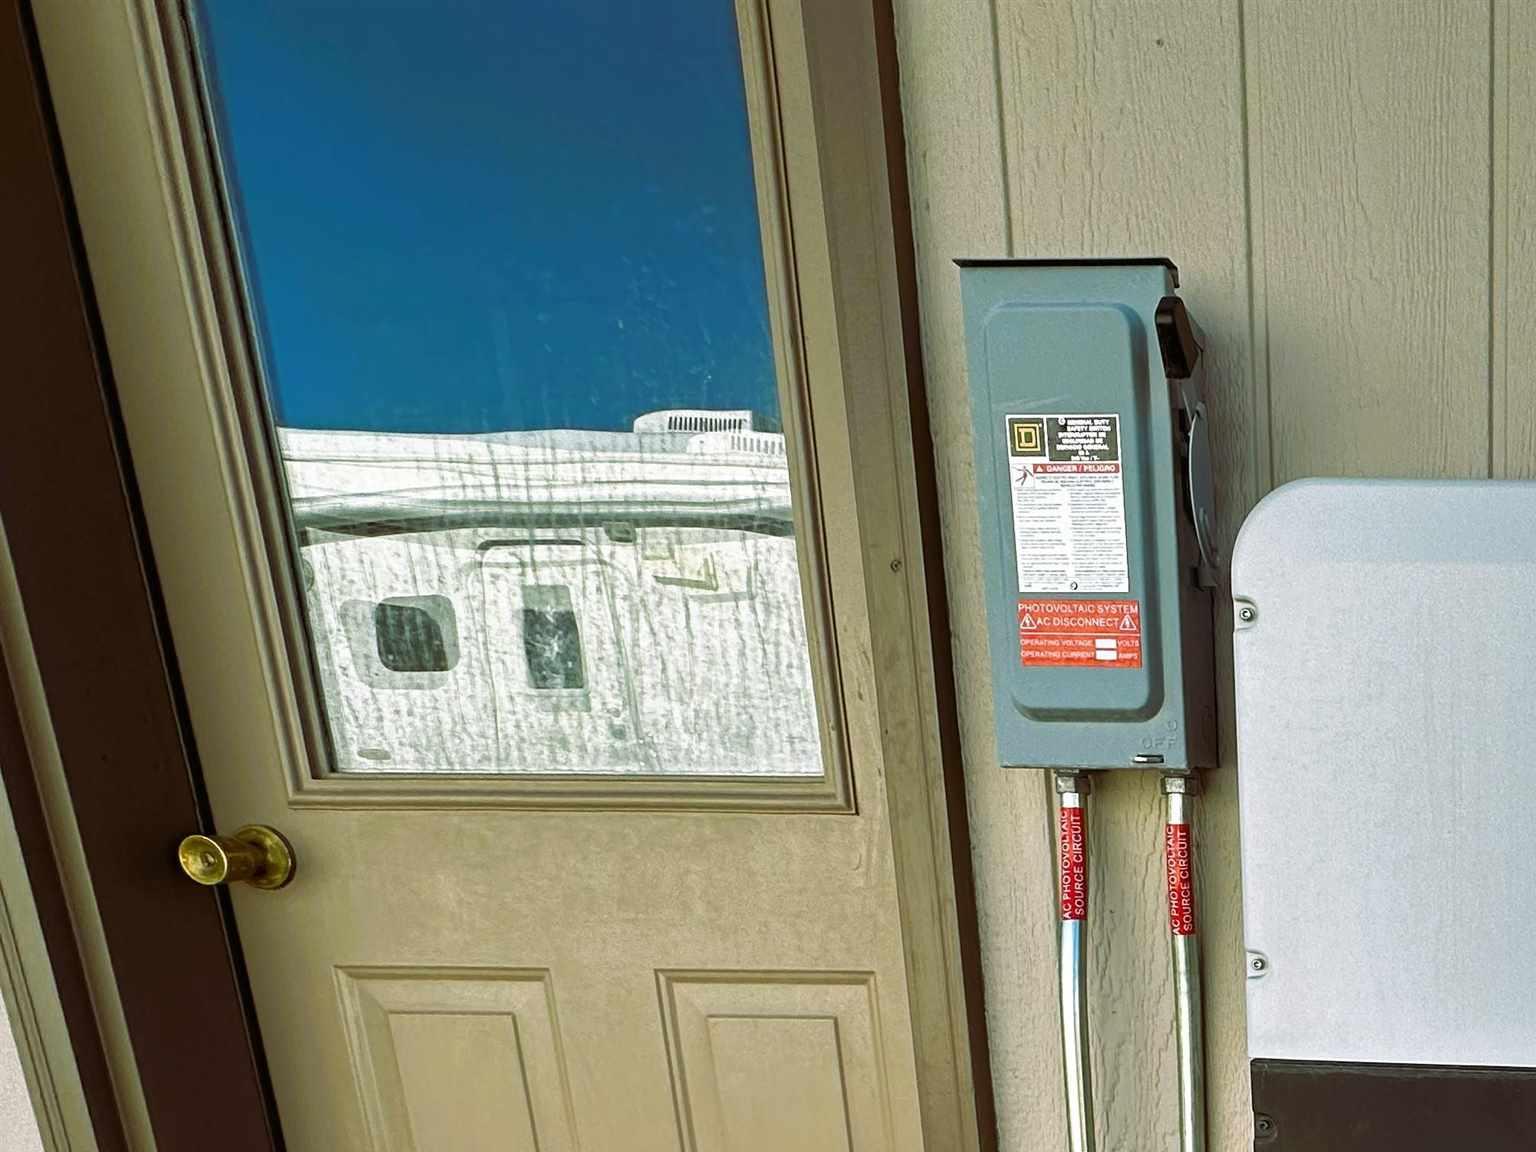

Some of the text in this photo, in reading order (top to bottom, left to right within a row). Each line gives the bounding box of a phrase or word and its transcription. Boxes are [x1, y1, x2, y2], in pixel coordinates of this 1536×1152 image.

[1046, 464, 1077, 472] DANGER
[1083, 464, 1116, 472] PELIGRO
[1018, 603, 1138, 614] PHOTOVOLTAIC SYSTEM
[1036, 616, 1119, 627] AC DISCONNECT
[1061, 810, 1072, 920] AC PHOTOVOLTAIC
[1070, 814, 1085, 916] SOURCE CIRCUIT
[1166, 826, 1181, 935] AC PHOTOVOLTAIC
[1177, 831, 1192, 931] SOURCE CIRCUIT
